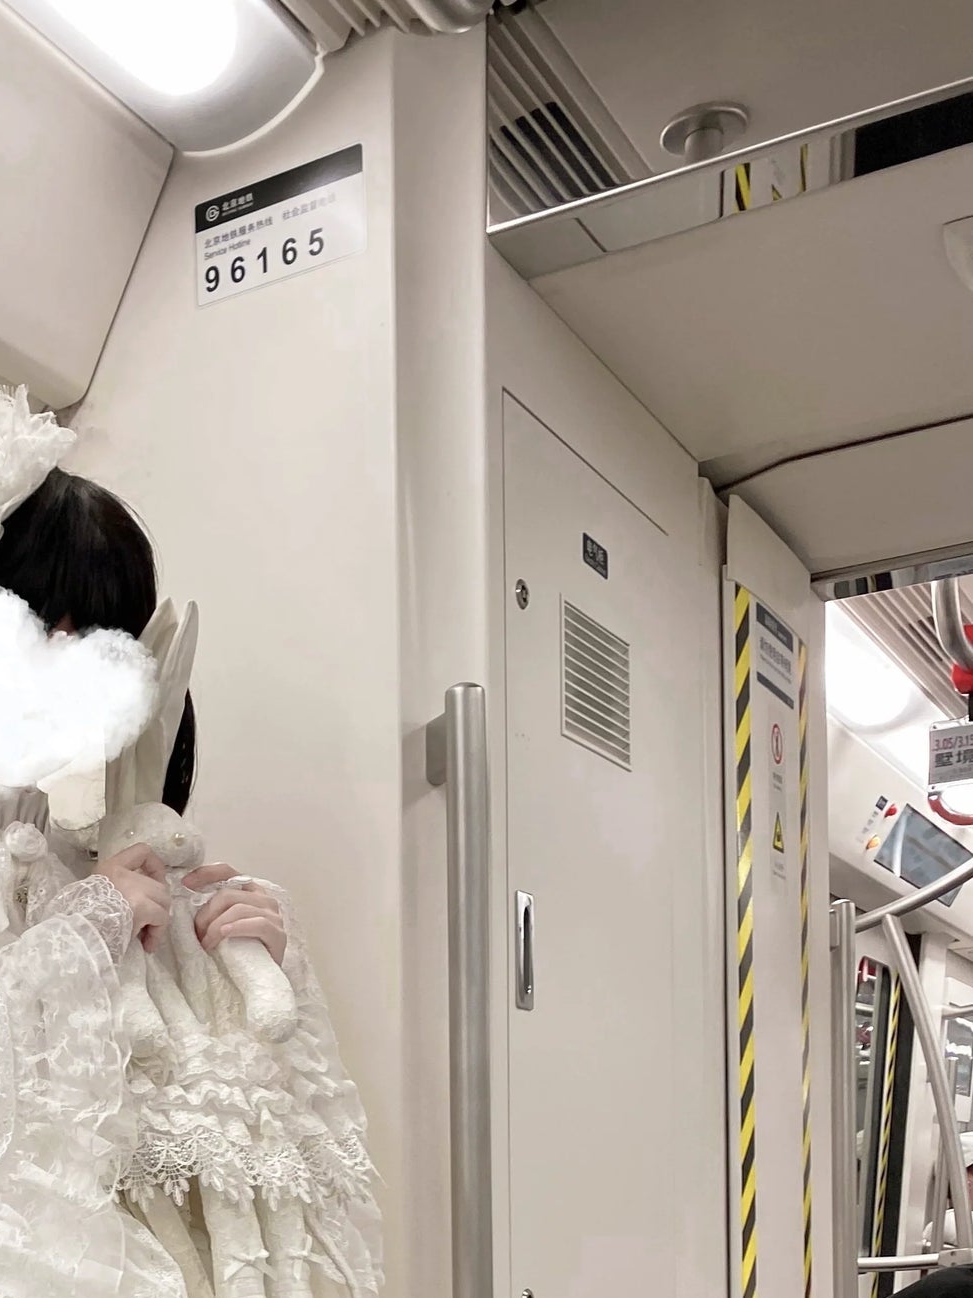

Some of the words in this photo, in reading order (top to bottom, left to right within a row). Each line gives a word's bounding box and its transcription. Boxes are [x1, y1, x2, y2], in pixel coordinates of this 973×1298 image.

[282, 192, 336, 221] 社会监督
[204, 227, 324, 293] 96165
